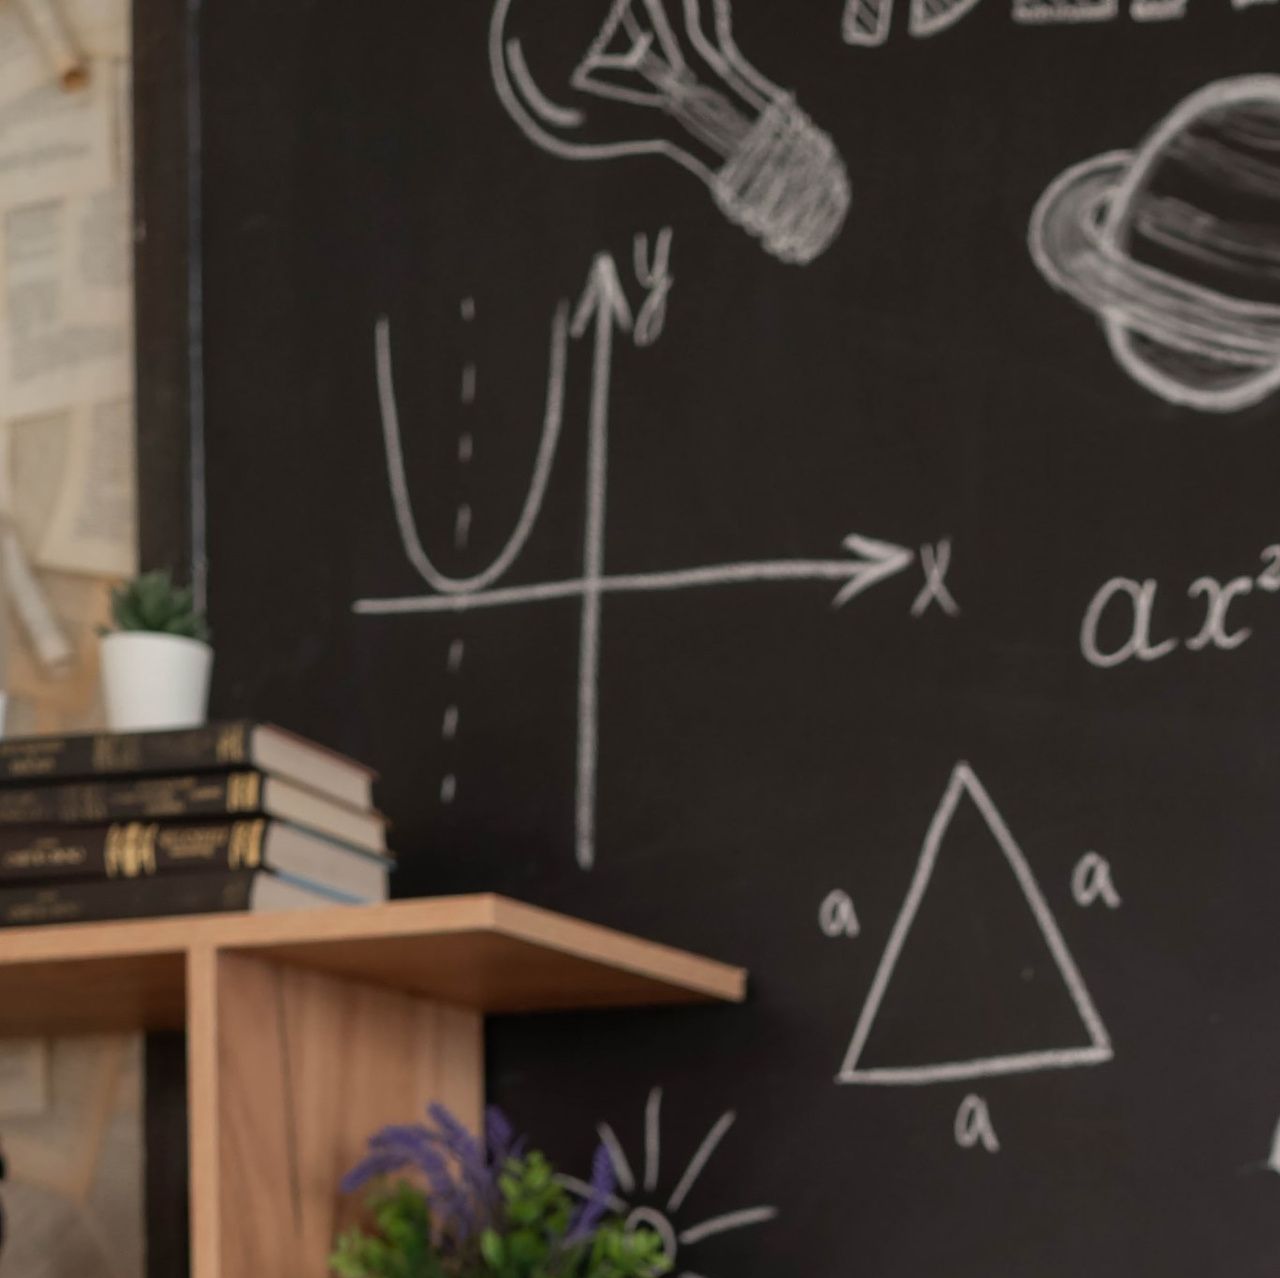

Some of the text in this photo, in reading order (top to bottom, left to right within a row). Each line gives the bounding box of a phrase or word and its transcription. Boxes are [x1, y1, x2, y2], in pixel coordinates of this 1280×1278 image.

[1069, 852, 1122, 909] a
[818, 888, 861, 938] a
[953, 1092, 1000, 1153] a
